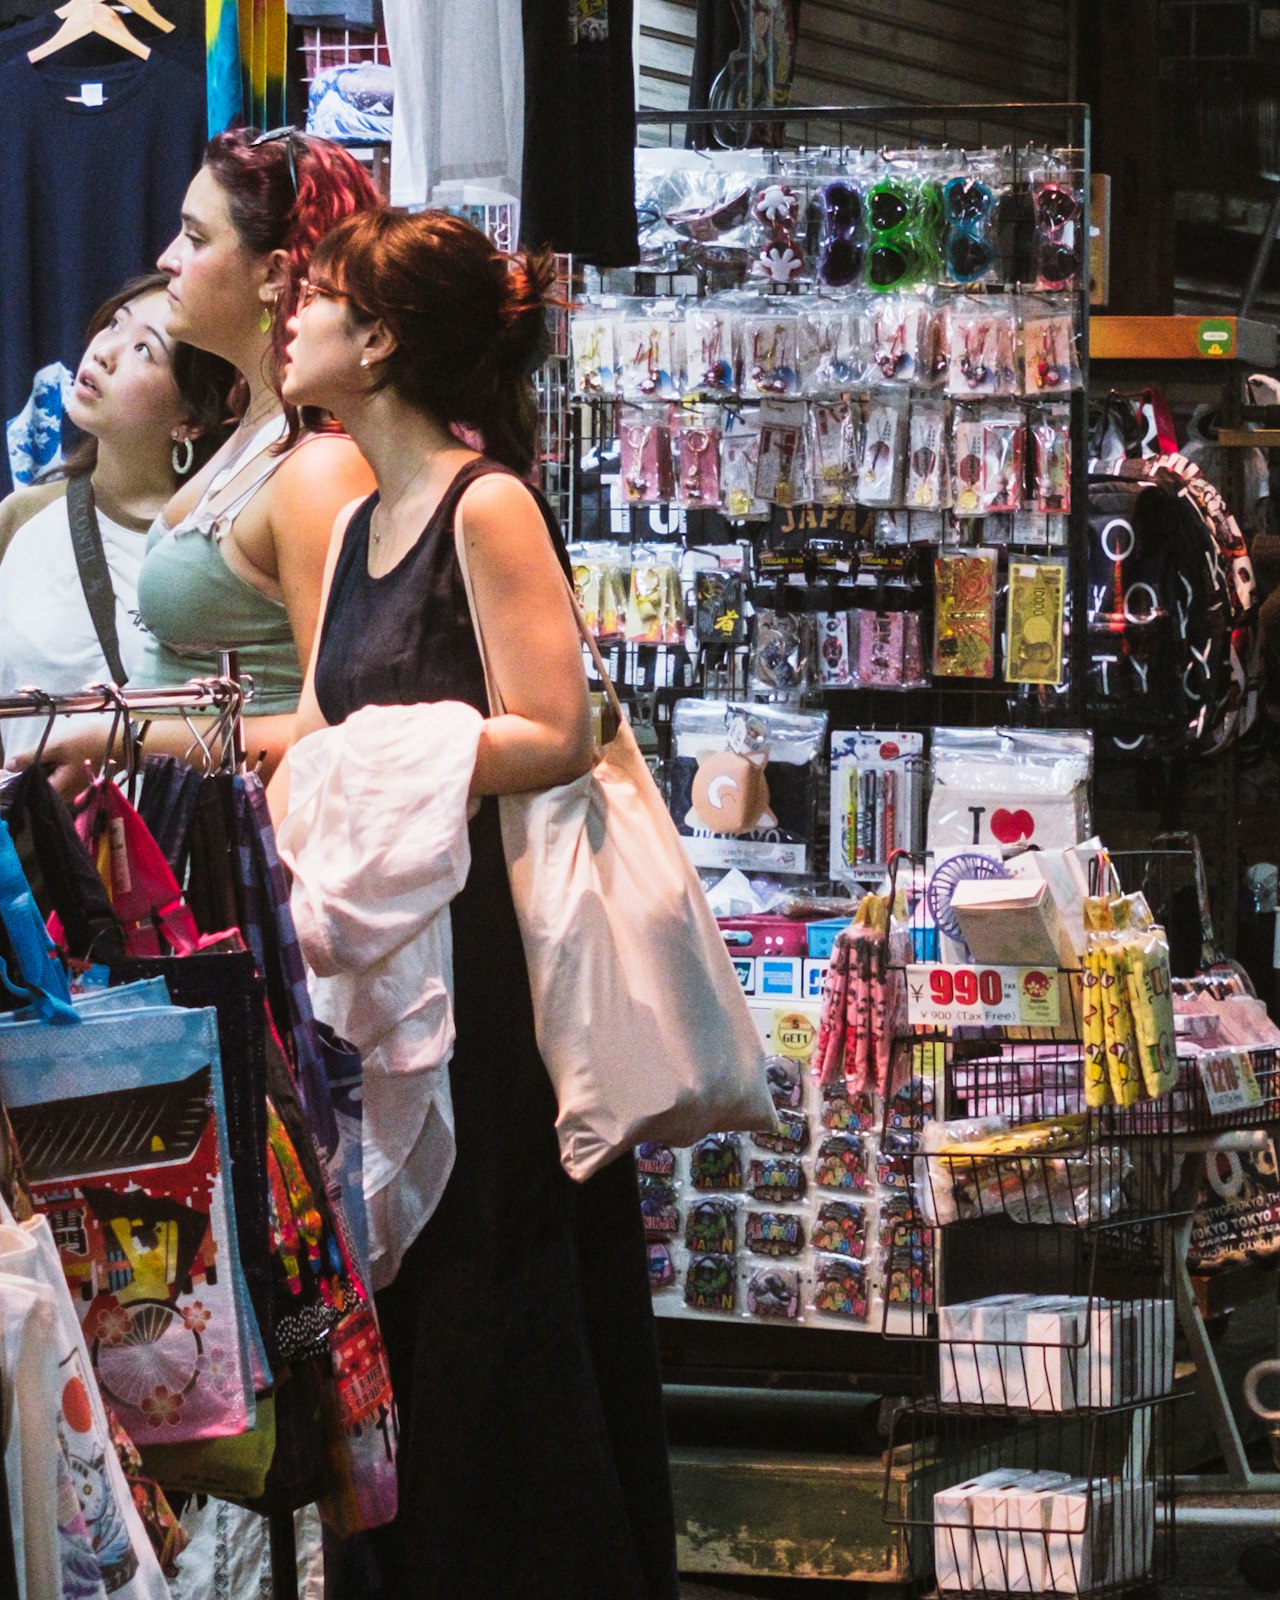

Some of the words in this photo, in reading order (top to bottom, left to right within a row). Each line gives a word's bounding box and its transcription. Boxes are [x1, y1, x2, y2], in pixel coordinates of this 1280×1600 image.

[929, 969, 1003, 1006] 990
[696, 1172, 742, 1189] JAPAN
[1231, 1209, 1272, 1229] TOKYO
[690, 1238, 734, 1253] JAPAN
